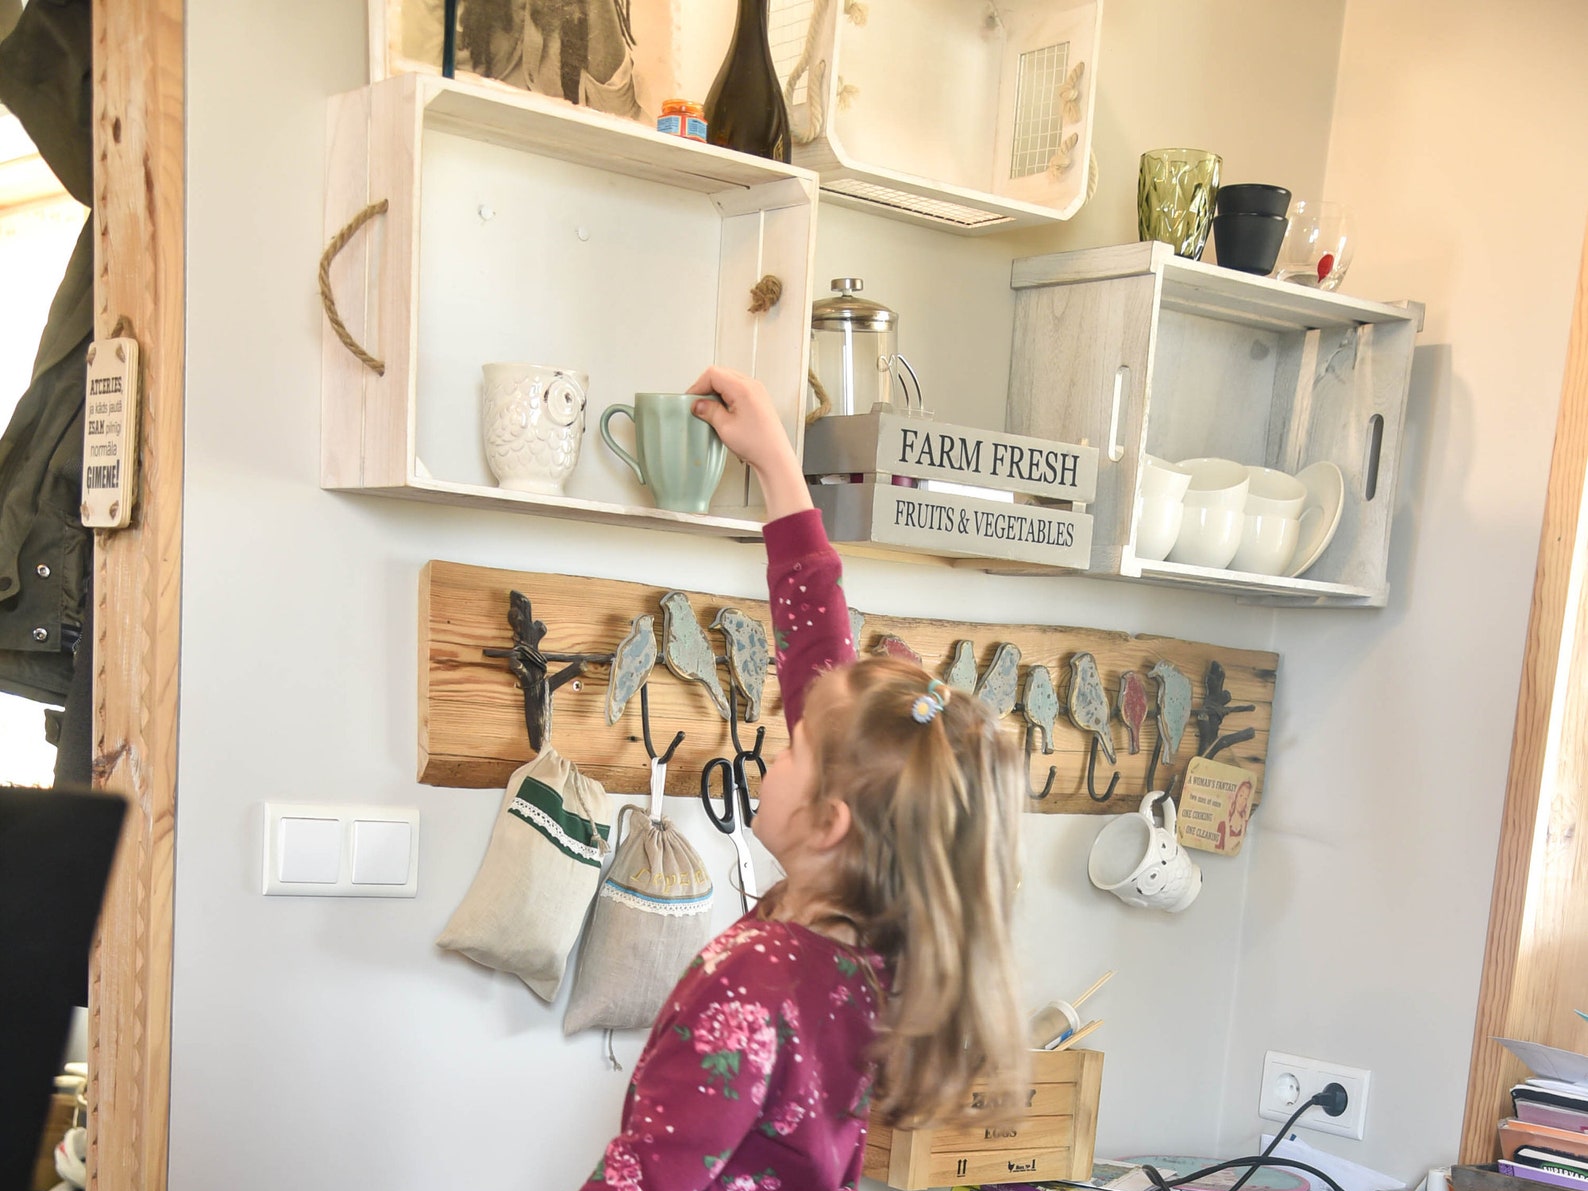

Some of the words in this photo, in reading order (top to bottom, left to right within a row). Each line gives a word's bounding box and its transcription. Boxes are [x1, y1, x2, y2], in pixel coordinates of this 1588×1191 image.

[899, 428, 983, 473] FARM
[990, 442, 1080, 487] FRESH
[894, 499, 954, 532] FRUITS
[957, 508, 969, 534] &
[974, 510, 1074, 548] VEGETABLES
